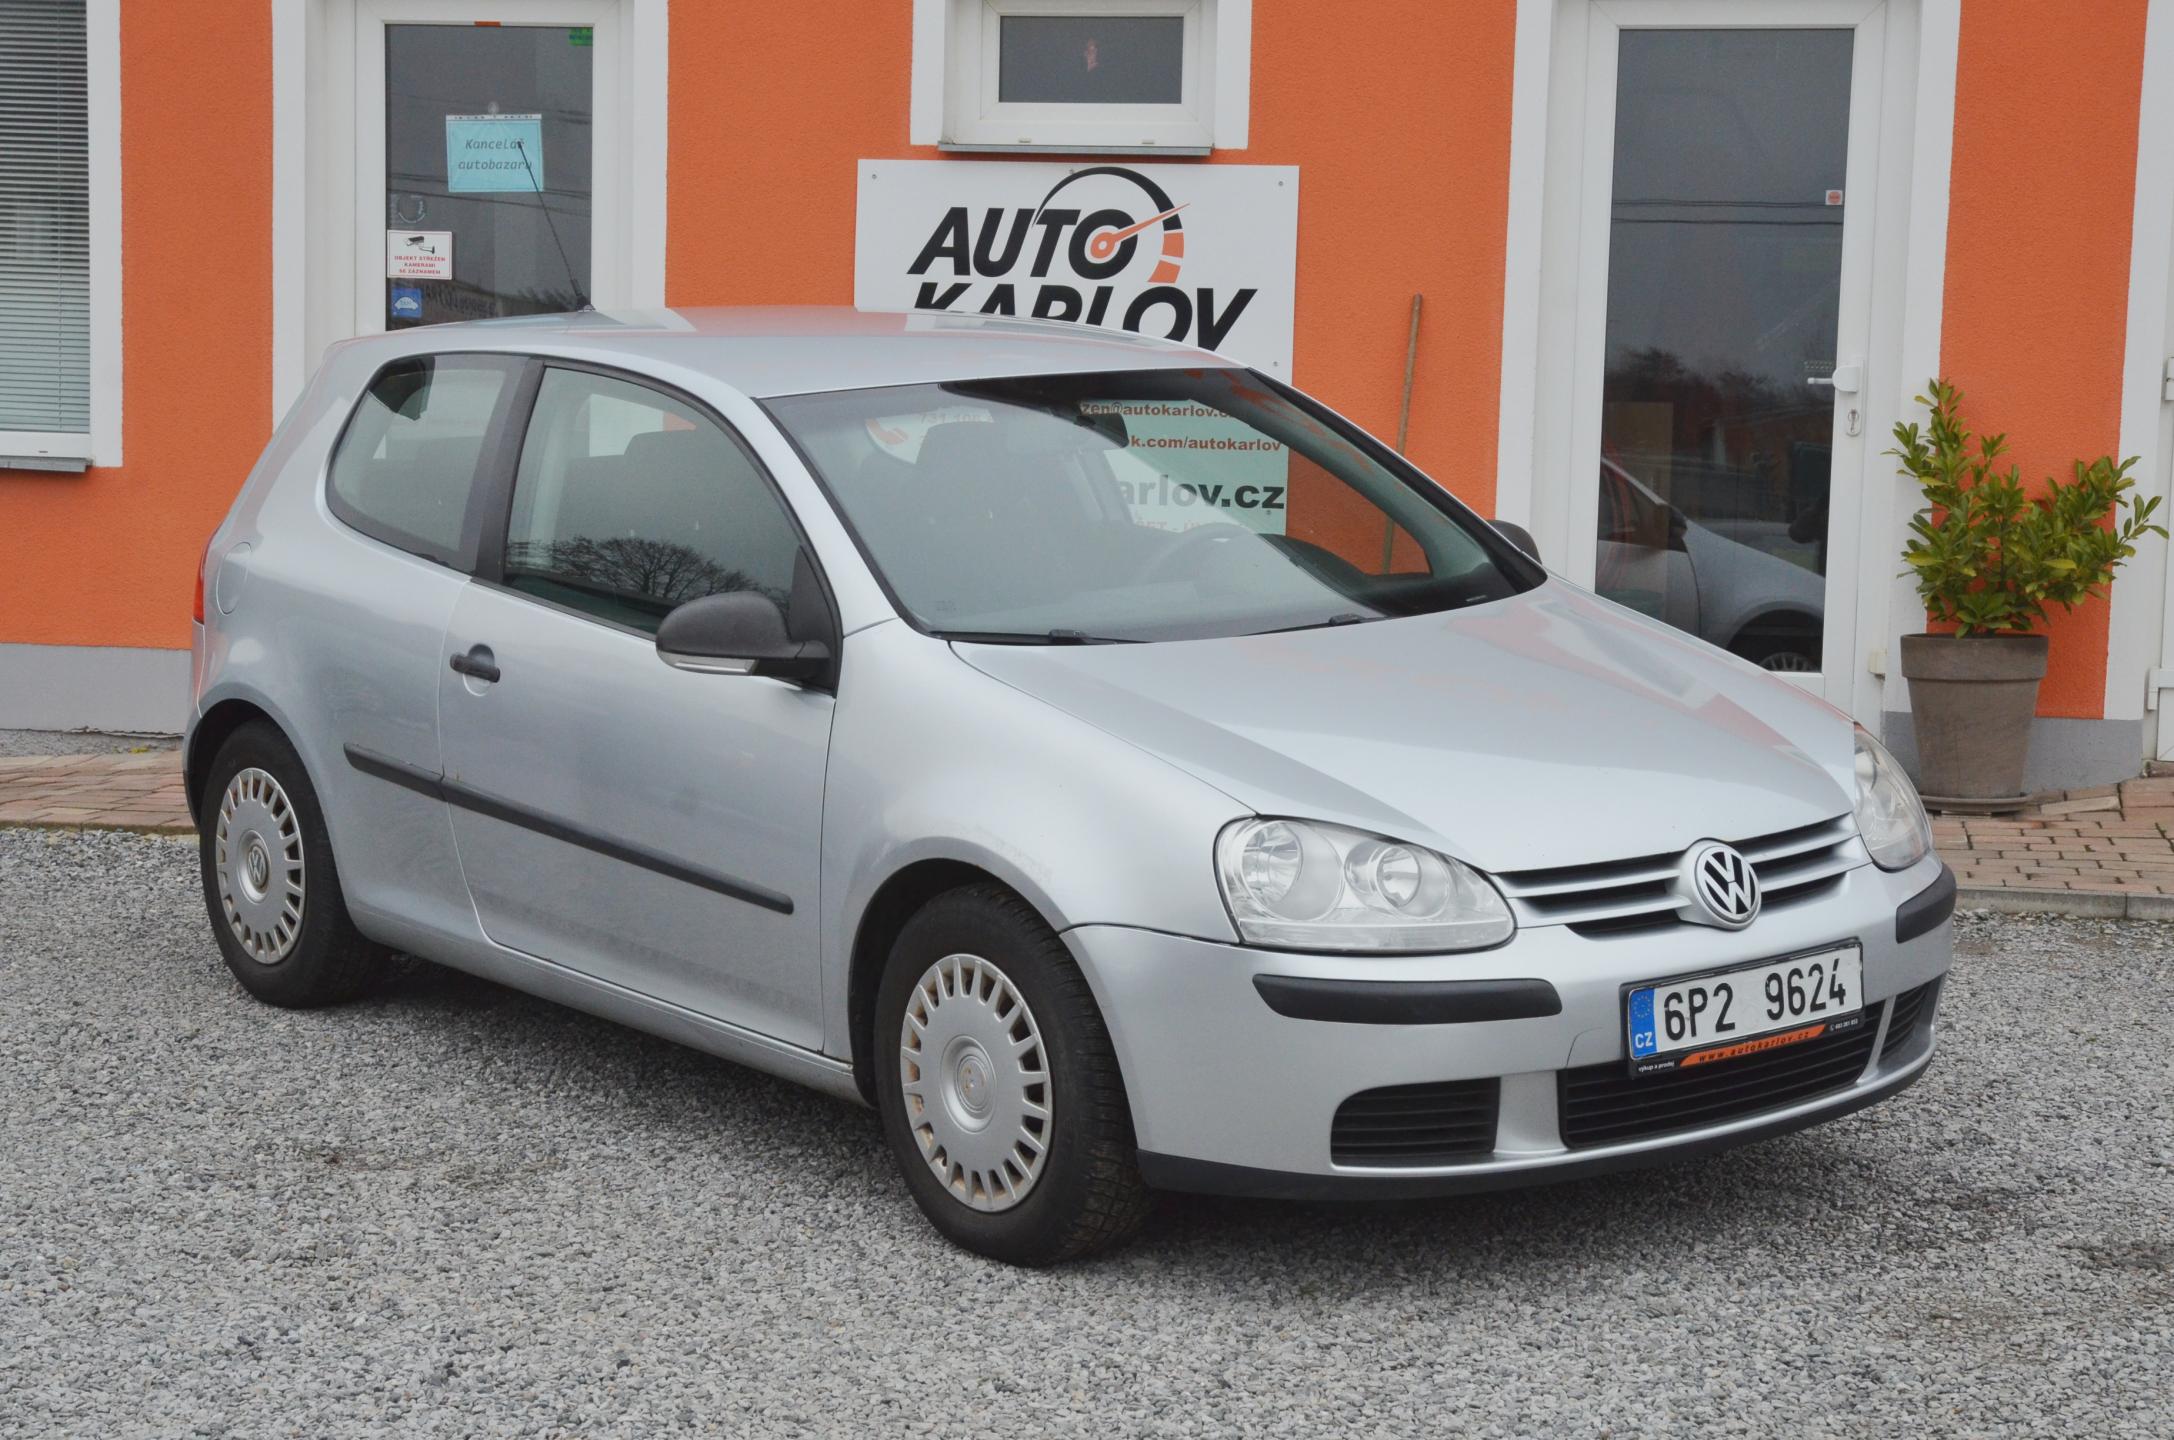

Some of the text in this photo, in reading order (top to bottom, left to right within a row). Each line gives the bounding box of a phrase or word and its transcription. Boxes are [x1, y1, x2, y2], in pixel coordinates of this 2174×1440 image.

[907, 207, 1138, 280] AUTO
[1664, 958, 1846, 1041] 6P2 9624
[1635, 1032, 1653, 1048] CZ
[1699, 1032, 1809, 1062] www.autokarlov.cz
